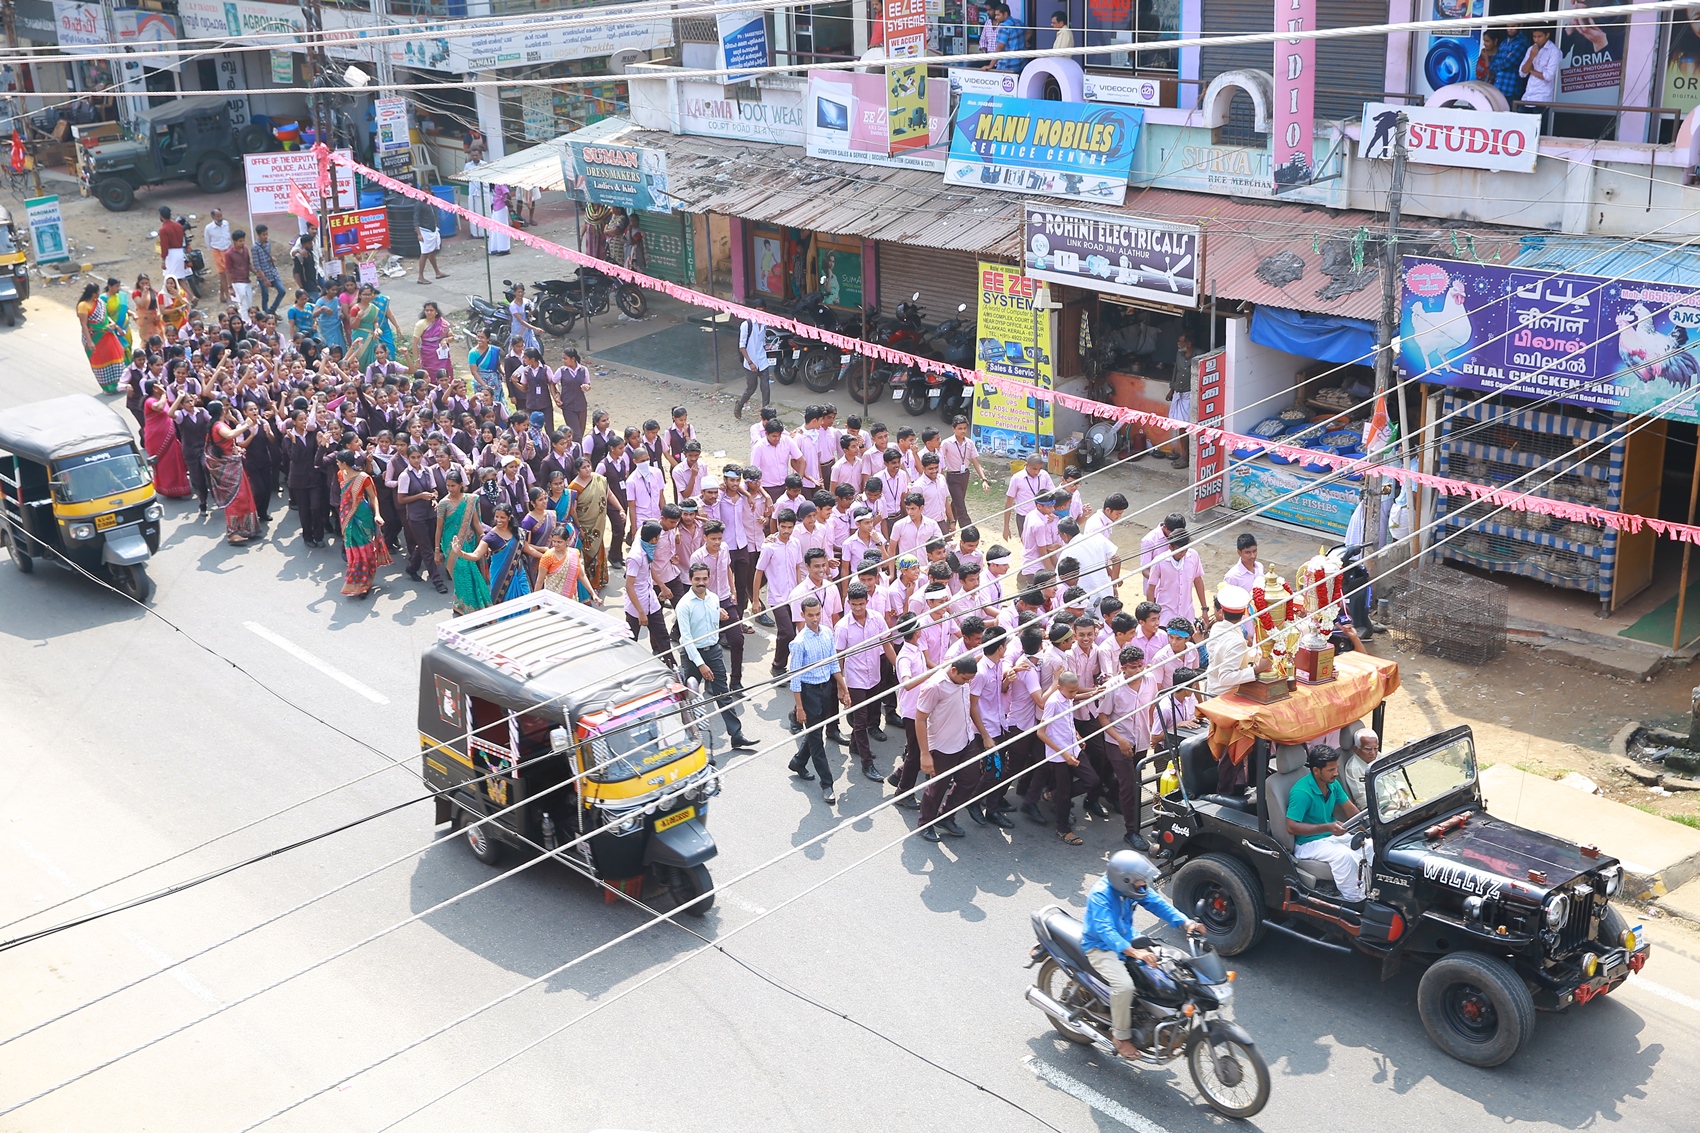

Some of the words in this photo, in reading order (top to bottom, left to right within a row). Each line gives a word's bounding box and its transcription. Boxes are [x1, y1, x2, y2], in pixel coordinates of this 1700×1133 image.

[889, 1, 901, 17] EE
[243, 13, 290, 33] AGROMART
[888, 14, 925, 32] SYSTEMS
[583, 42, 615, 54] makita
[1563, 67, 1583, 75] DIGITAL
[1583, 62, 1621, 71] PHOTOGRAPHY
[964, 77, 999, 86] VIDEOCON
[1563, 75, 1583, 83] DIGITAL
[1584, 71, 1620, 80] VIDEOGRAPHY
[1596, 79, 1620, 88] MODELIN
[1099, 85, 1138, 93] VIDEOCON
[771, 105, 803, 126] WEAR
[708, 121, 729, 131] COURT
[732, 123, 750, 133] ROAD
[975, 113, 1031, 144] MANU
[1032, 118, 1115, 152] MOBILES
[1408, 122, 1526, 157] STUDIO
[251, 158, 270, 166] OFFICE
[271, 156, 279, 164] OF
[280, 156, 291, 164] THE
[292, 155, 315, 163] DEPUTY
[583, 147, 638, 168] SUMAN
[818, 148, 838, 156] COMPUTER
[838, 149, 849, 157] SALES
[970, 141, 1035, 159] SERVICE
[1047, 149, 1107, 166] CENTRE
[1182, 146, 1251, 175] SURYA
[384, 157, 409, 166] ADVOCATE
[586, 167, 610, 179] DRESS
[610, 170, 641, 183] MAKERS
[1208, 175, 1227, 184] RICE
[1231, 177, 1272, 189] MERCHAN
[254, 185, 275, 193] OFFICE
[593, 180, 614, 191] Ladies
[622, 184, 637, 194] Kids
[330, 218, 341, 228] EE
[342, 214, 359, 226] ZEE
[1045, 213, 1095, 244] ROHINI
[1099, 220, 1188, 256] ELECTRICALS
[685, 227, 697, 284] SERVICING
[1066, 238, 1082, 248] LINK
[1083, 241, 1104, 251] ROAD
[1105, 245, 1117, 253] JN.
[1118, 247, 1150, 259] ALATHUR
[842, 274, 862, 284] SUMA
[982, 270, 1004, 293] EE
[983, 292, 1045, 312] SYSTEM
[1006, 307, 1030, 316] Computer
[1007, 327, 1025, 335] KERALA
[989, 362, 1007, 372] Sales
[1007, 366, 1013, 374] &
[1014, 367, 1041, 377] Servic
[1463, 363, 1505, 379] BILAL
[1508, 370, 1581, 390] CHICKEN
[1584, 382, 1630, 397] FARM
[1481, 379, 1495, 388] AMS
[1522, 385, 1535, 393] Link
[1536, 387, 1552, 396] Road
[1580, 394, 1596, 402] Road
[1596, 396, 1621, 406] Alathur
[980, 410, 996, 418] CCTV
[997, 413, 1020, 423] Security
[1022, 418, 1044, 426] Camra
[993, 405, 1008, 413] ADSL
[1010, 407, 1031, 416] Modem
[1200, 462, 1217, 480] DRY
[1195, 478, 1223, 500] FISHES
[1302, 498, 1338, 514] FISHES
[1376, 873, 1410, 888] THAR
[1423, 860, 1504, 900] WILLYZ
